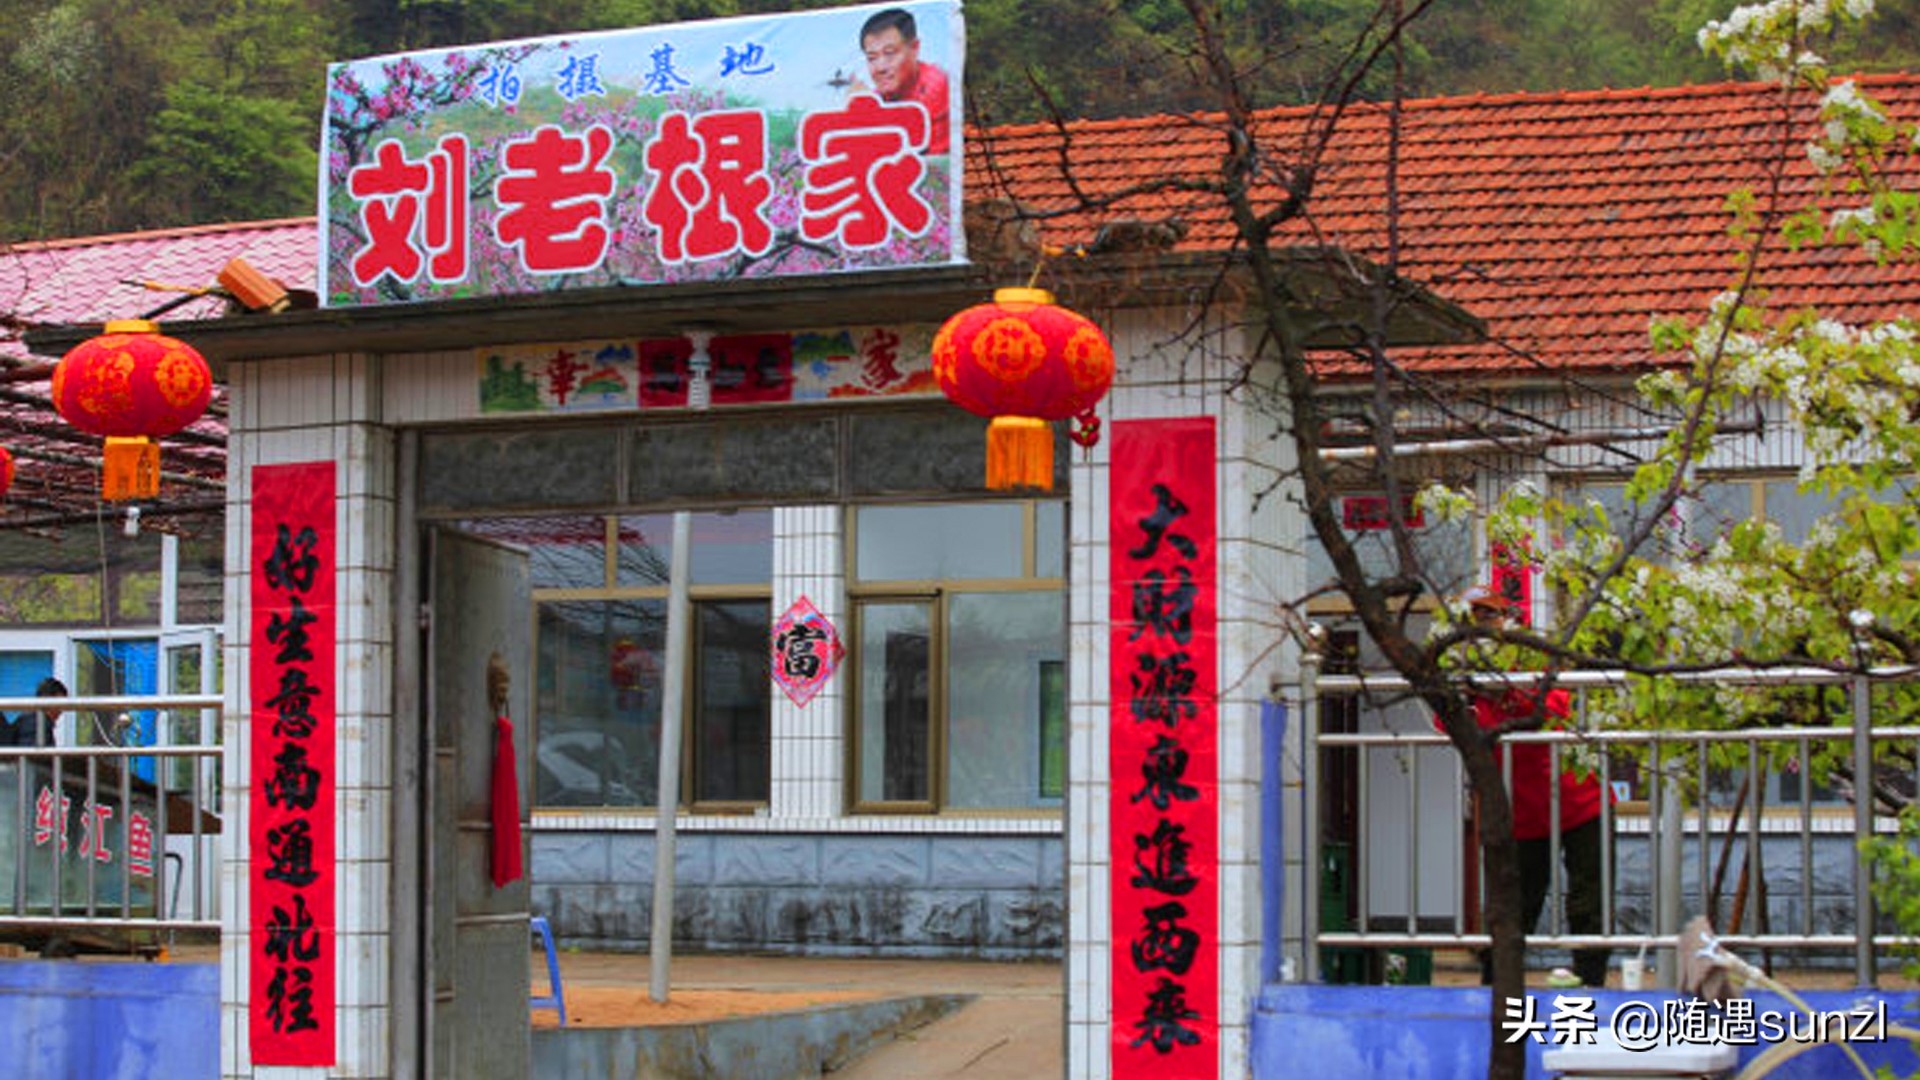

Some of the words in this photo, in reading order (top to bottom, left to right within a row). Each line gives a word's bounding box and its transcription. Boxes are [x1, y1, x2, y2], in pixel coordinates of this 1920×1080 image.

[478, 42, 775, 102] 拍摄基地
[349, 95, 933, 286] 刘老根家
[776, 623, 827, 679] 富
[263, 522, 321, 1034] 好生意南通北往
